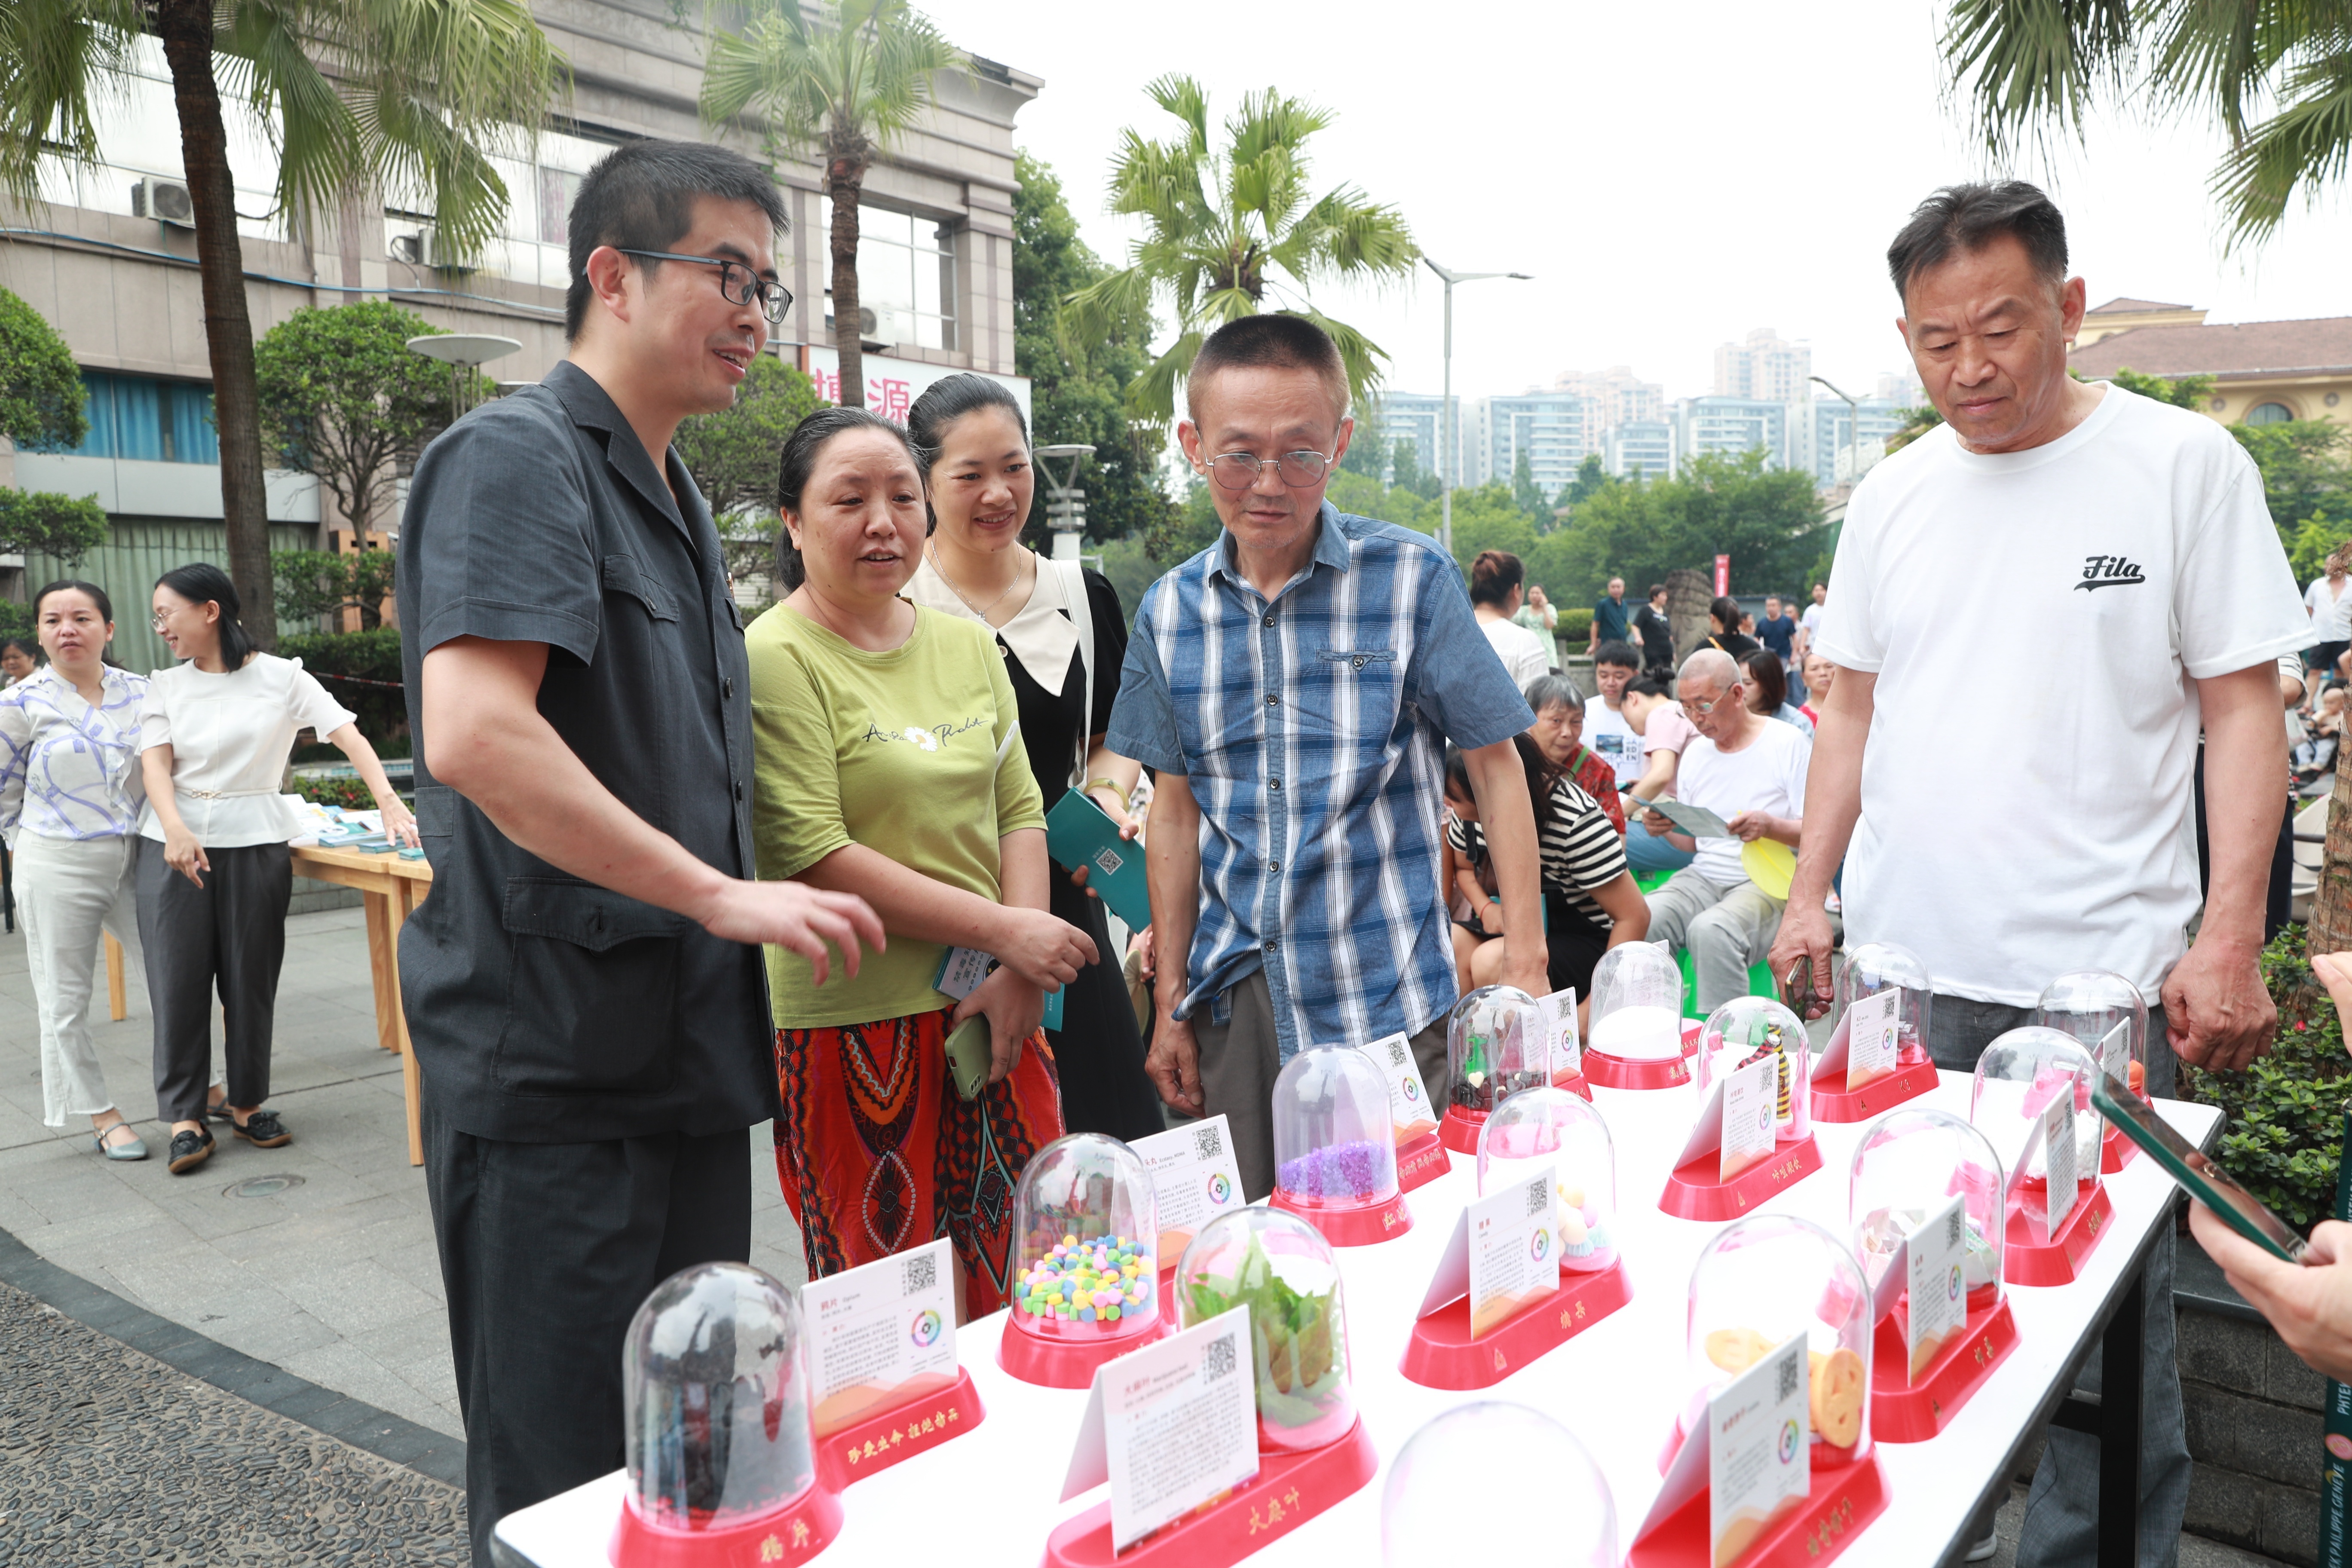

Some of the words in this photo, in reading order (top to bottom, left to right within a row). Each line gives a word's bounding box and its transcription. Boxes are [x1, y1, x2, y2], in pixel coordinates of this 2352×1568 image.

[2082, 555, 2145, 581] Fila
[1898, 1079, 1911, 1093] K3
[847, 1429, 903, 1464] 珍爱生命
[908, 1408, 959, 1439] 拒绝毒品
[1249, 1486, 1299, 1535] 大麻叶
